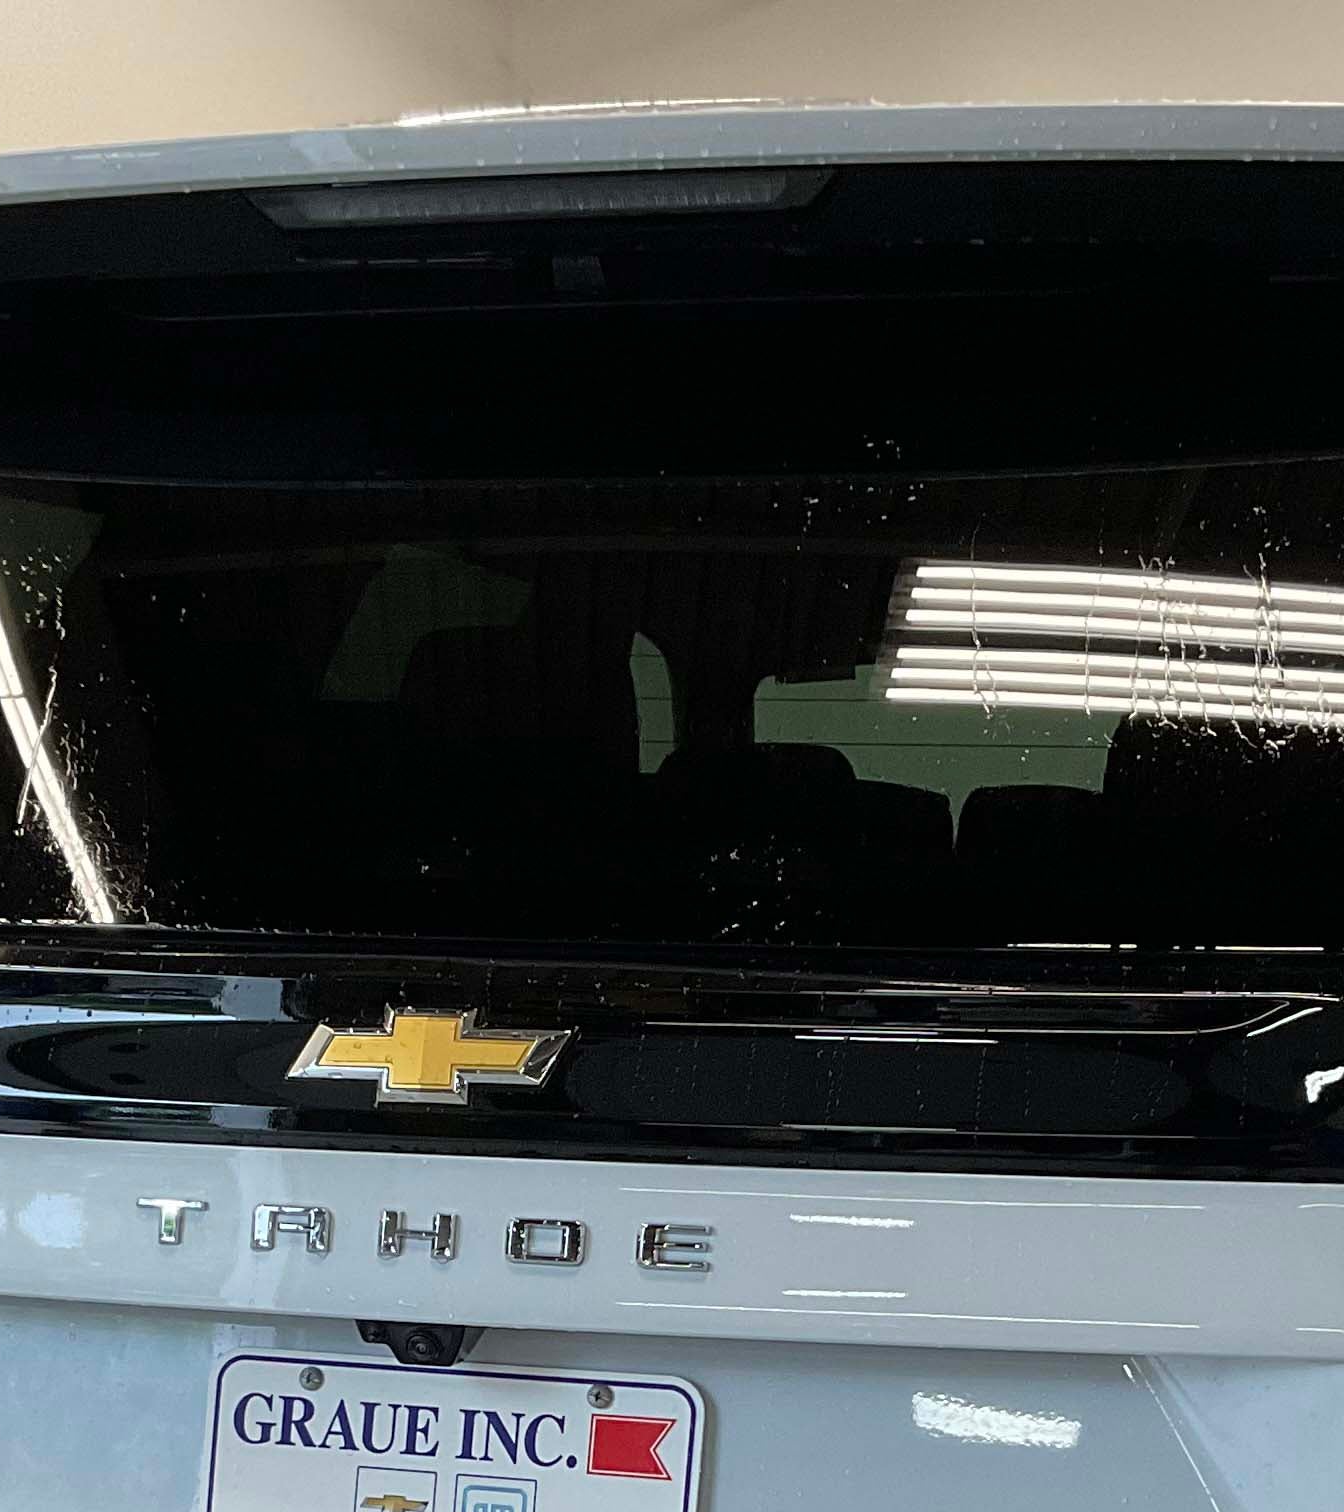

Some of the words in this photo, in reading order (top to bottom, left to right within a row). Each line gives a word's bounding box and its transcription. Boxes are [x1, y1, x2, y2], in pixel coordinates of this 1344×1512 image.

[136, 1198, 713, 1272] TAHOE
[233, 1392, 440, 1457] GRAUE
[455, 1408, 577, 1469] INC.
